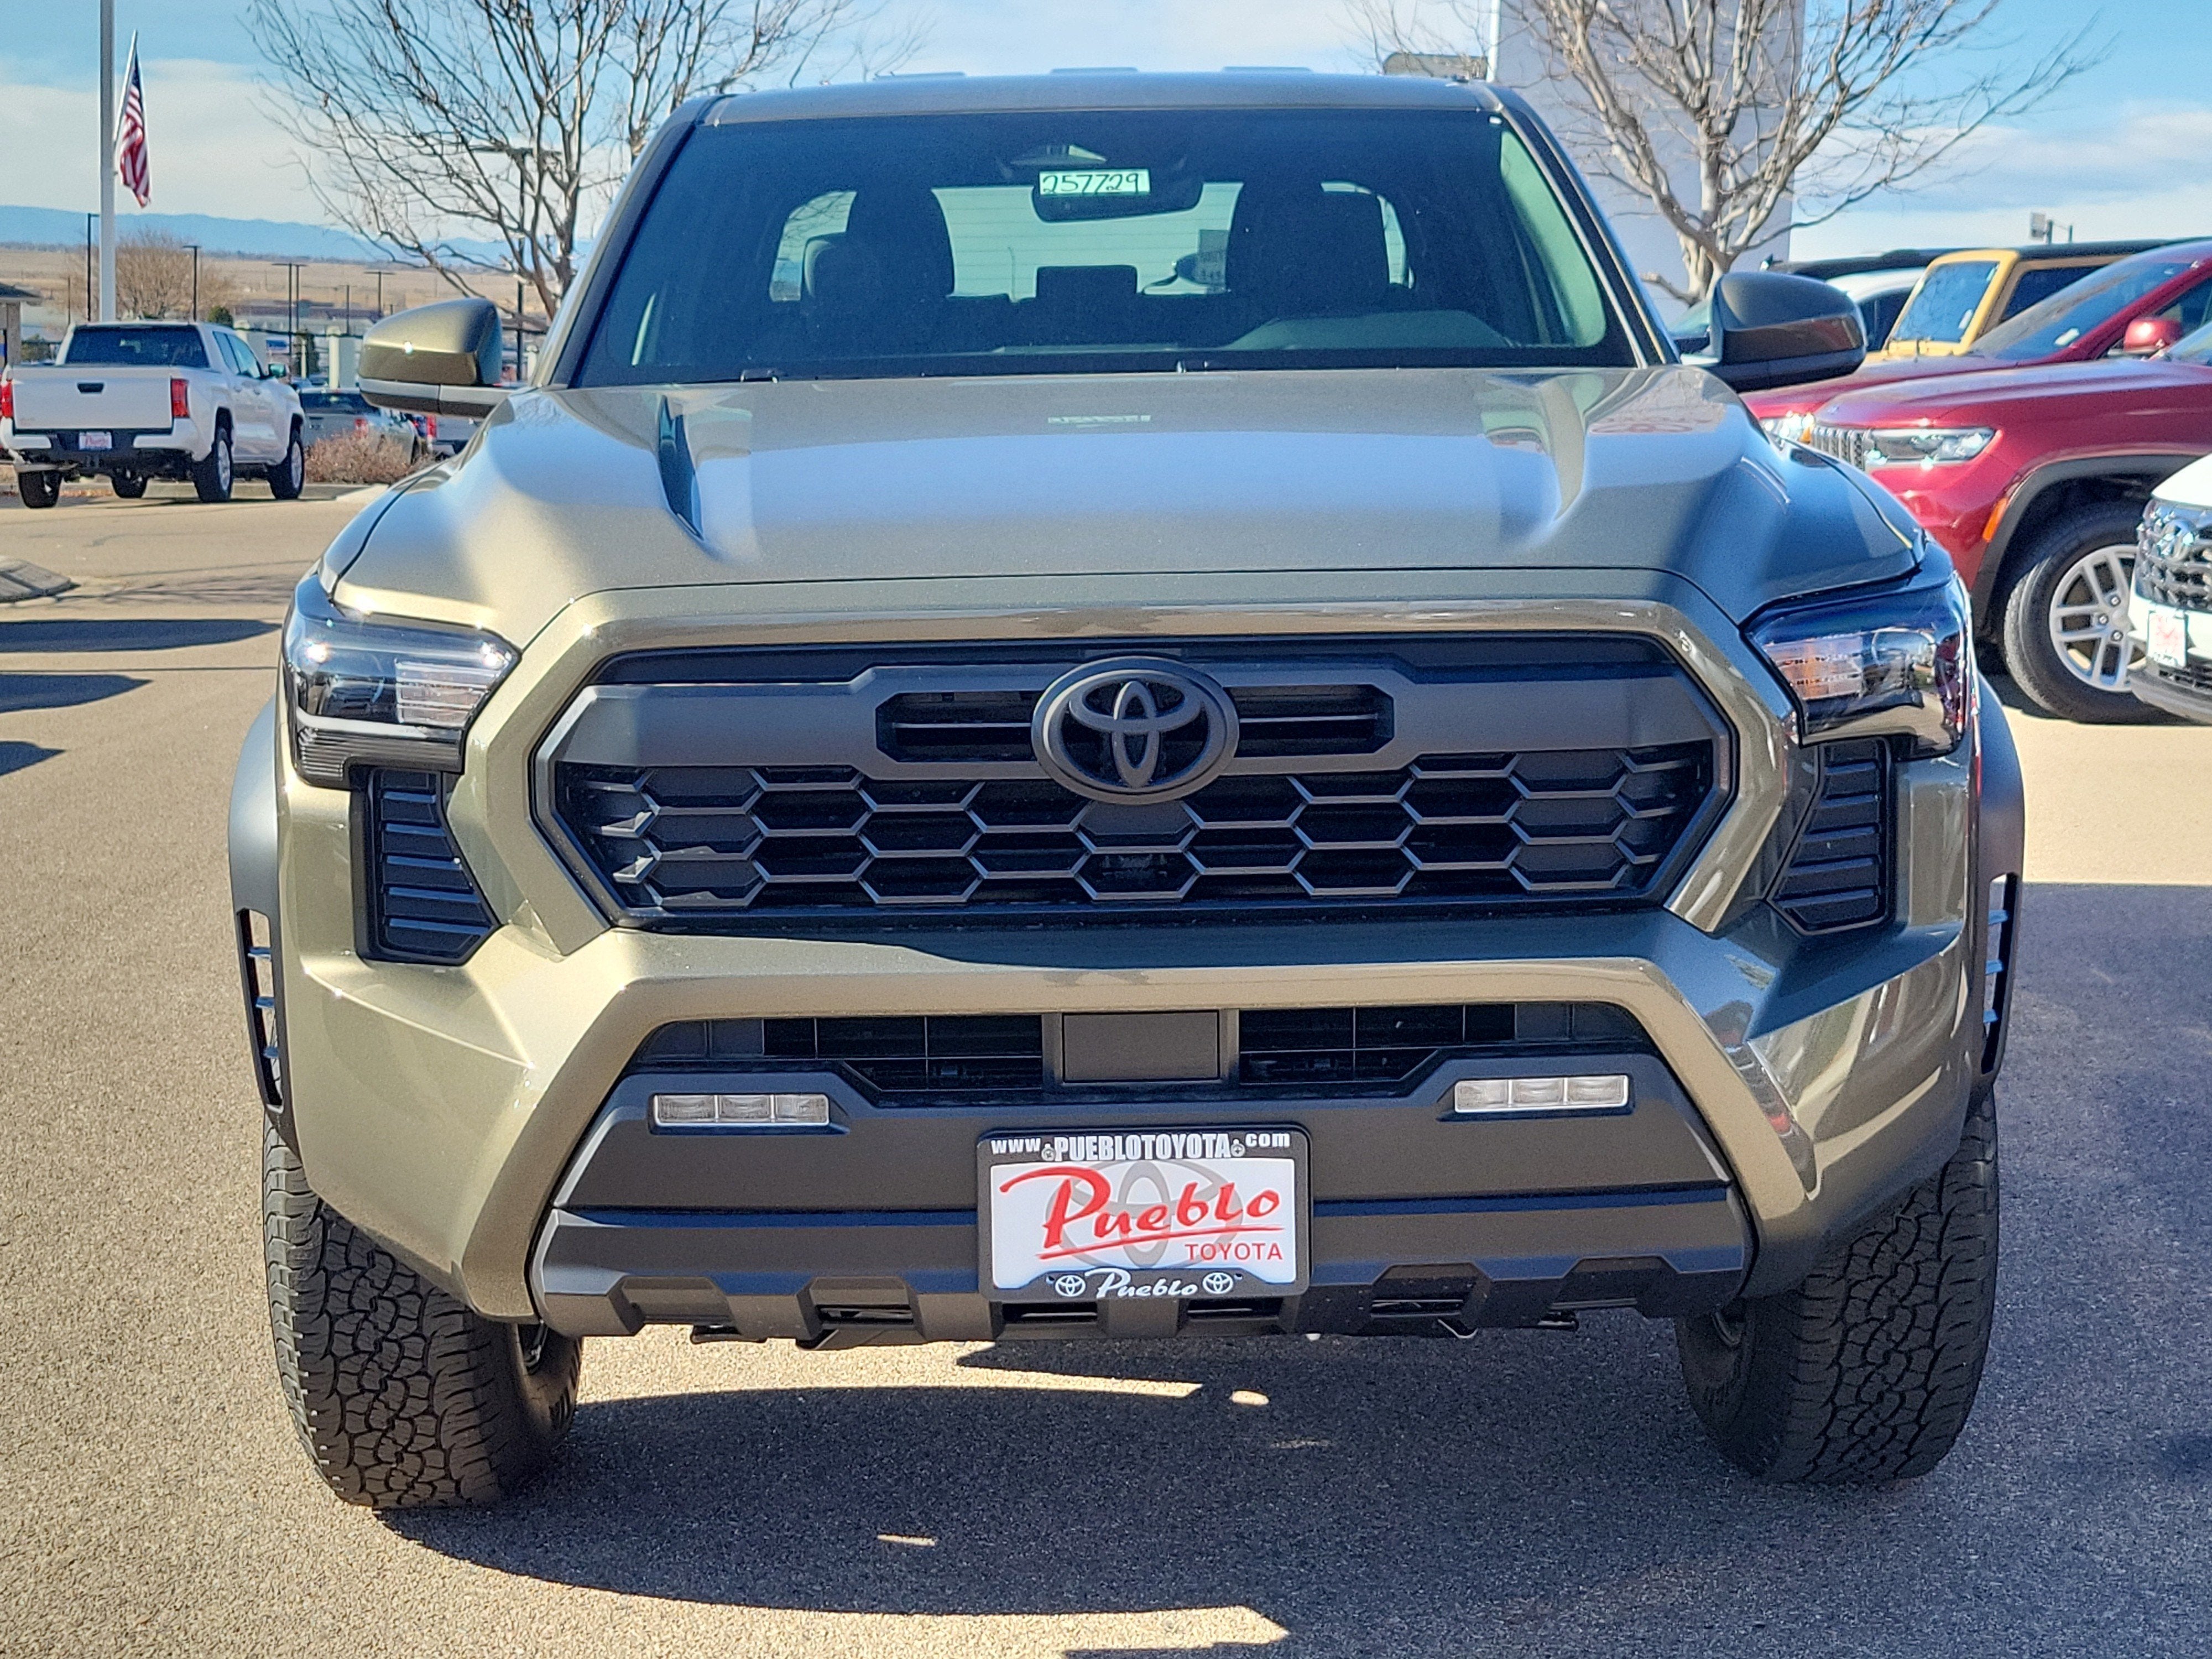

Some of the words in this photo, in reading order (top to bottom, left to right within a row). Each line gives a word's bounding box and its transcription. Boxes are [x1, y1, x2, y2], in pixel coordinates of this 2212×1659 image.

[1042, 173, 1139, 195] 257729
[999, 1165, 1280, 1249] Pueblo
[1185, 1242, 1284, 1261] TOYOTA
[1084, 1267, 1199, 1298] Pueblo
